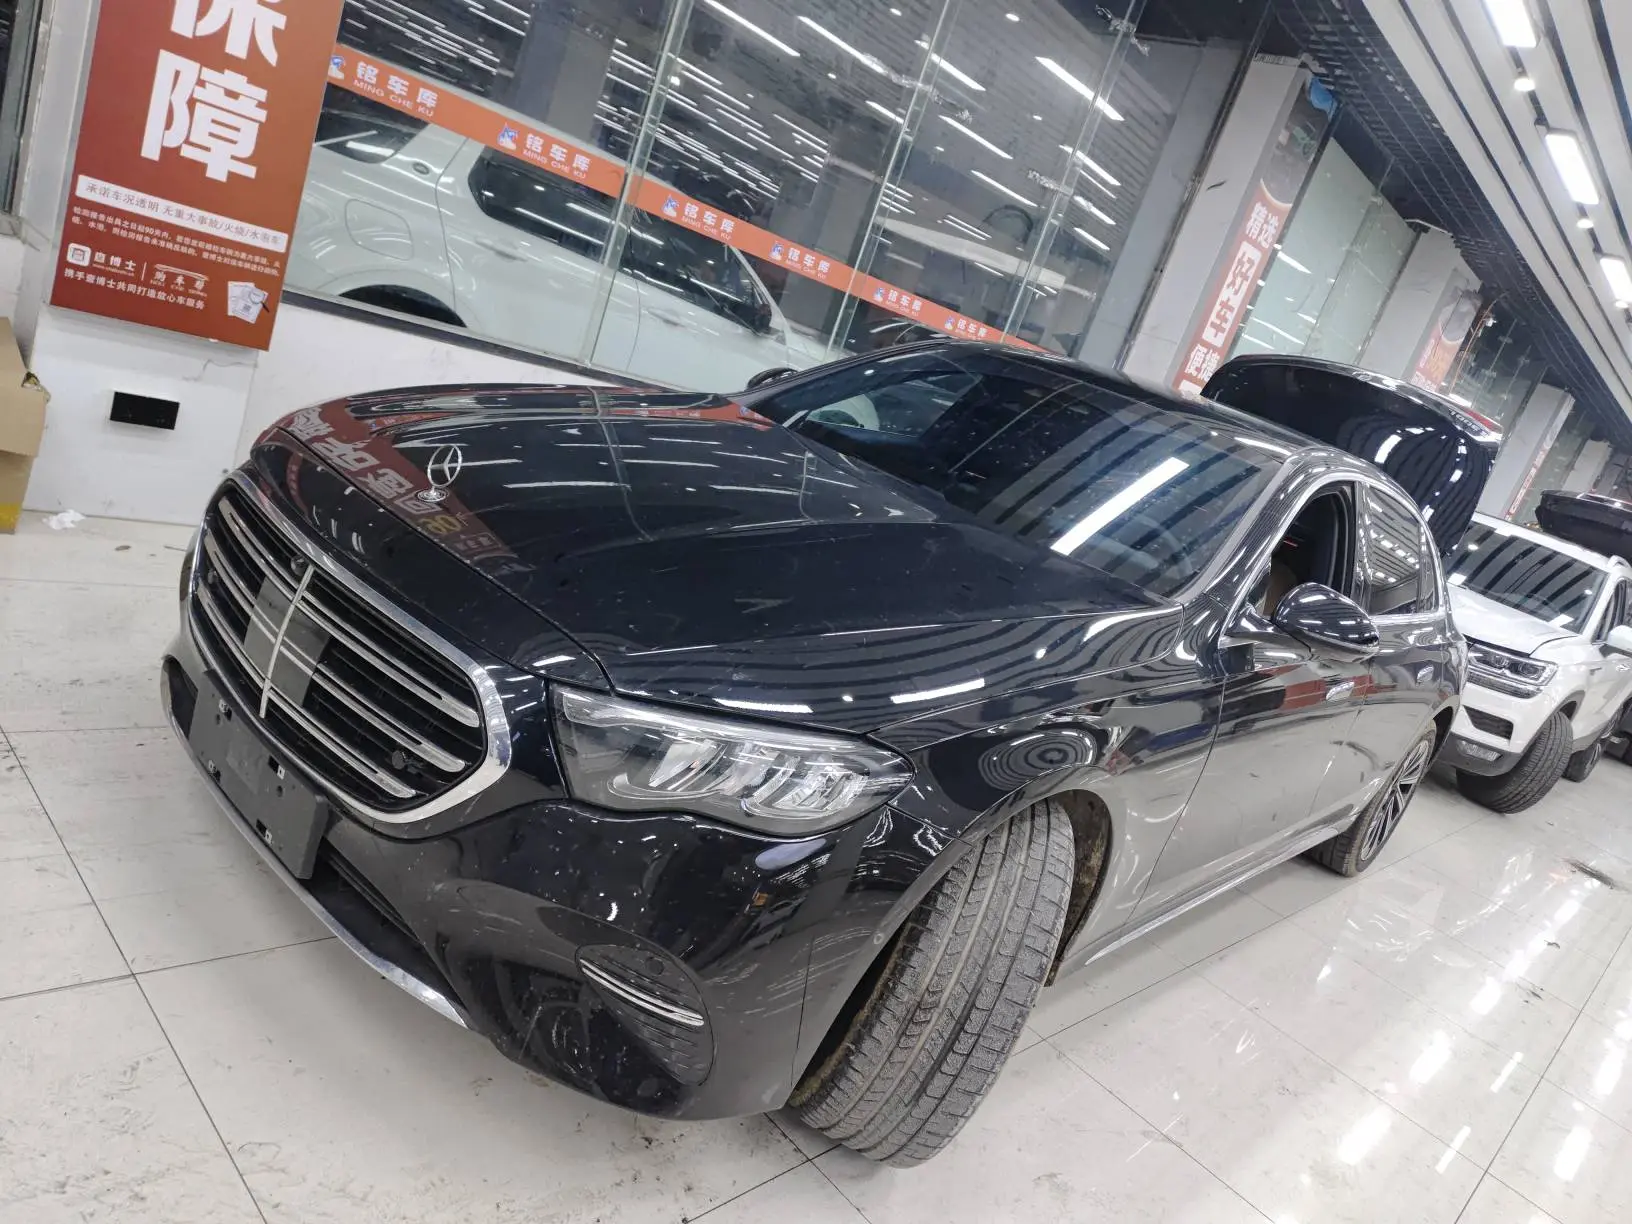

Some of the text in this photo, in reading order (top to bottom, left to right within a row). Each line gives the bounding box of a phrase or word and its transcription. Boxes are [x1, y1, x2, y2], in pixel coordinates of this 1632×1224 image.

[353, 79, 434, 117] MING CHE KU
[86, 183, 159, 213] 承诺车况透明
[1245, 201, 1279, 248] 精选
[1209, 252, 1254, 338] 好车
